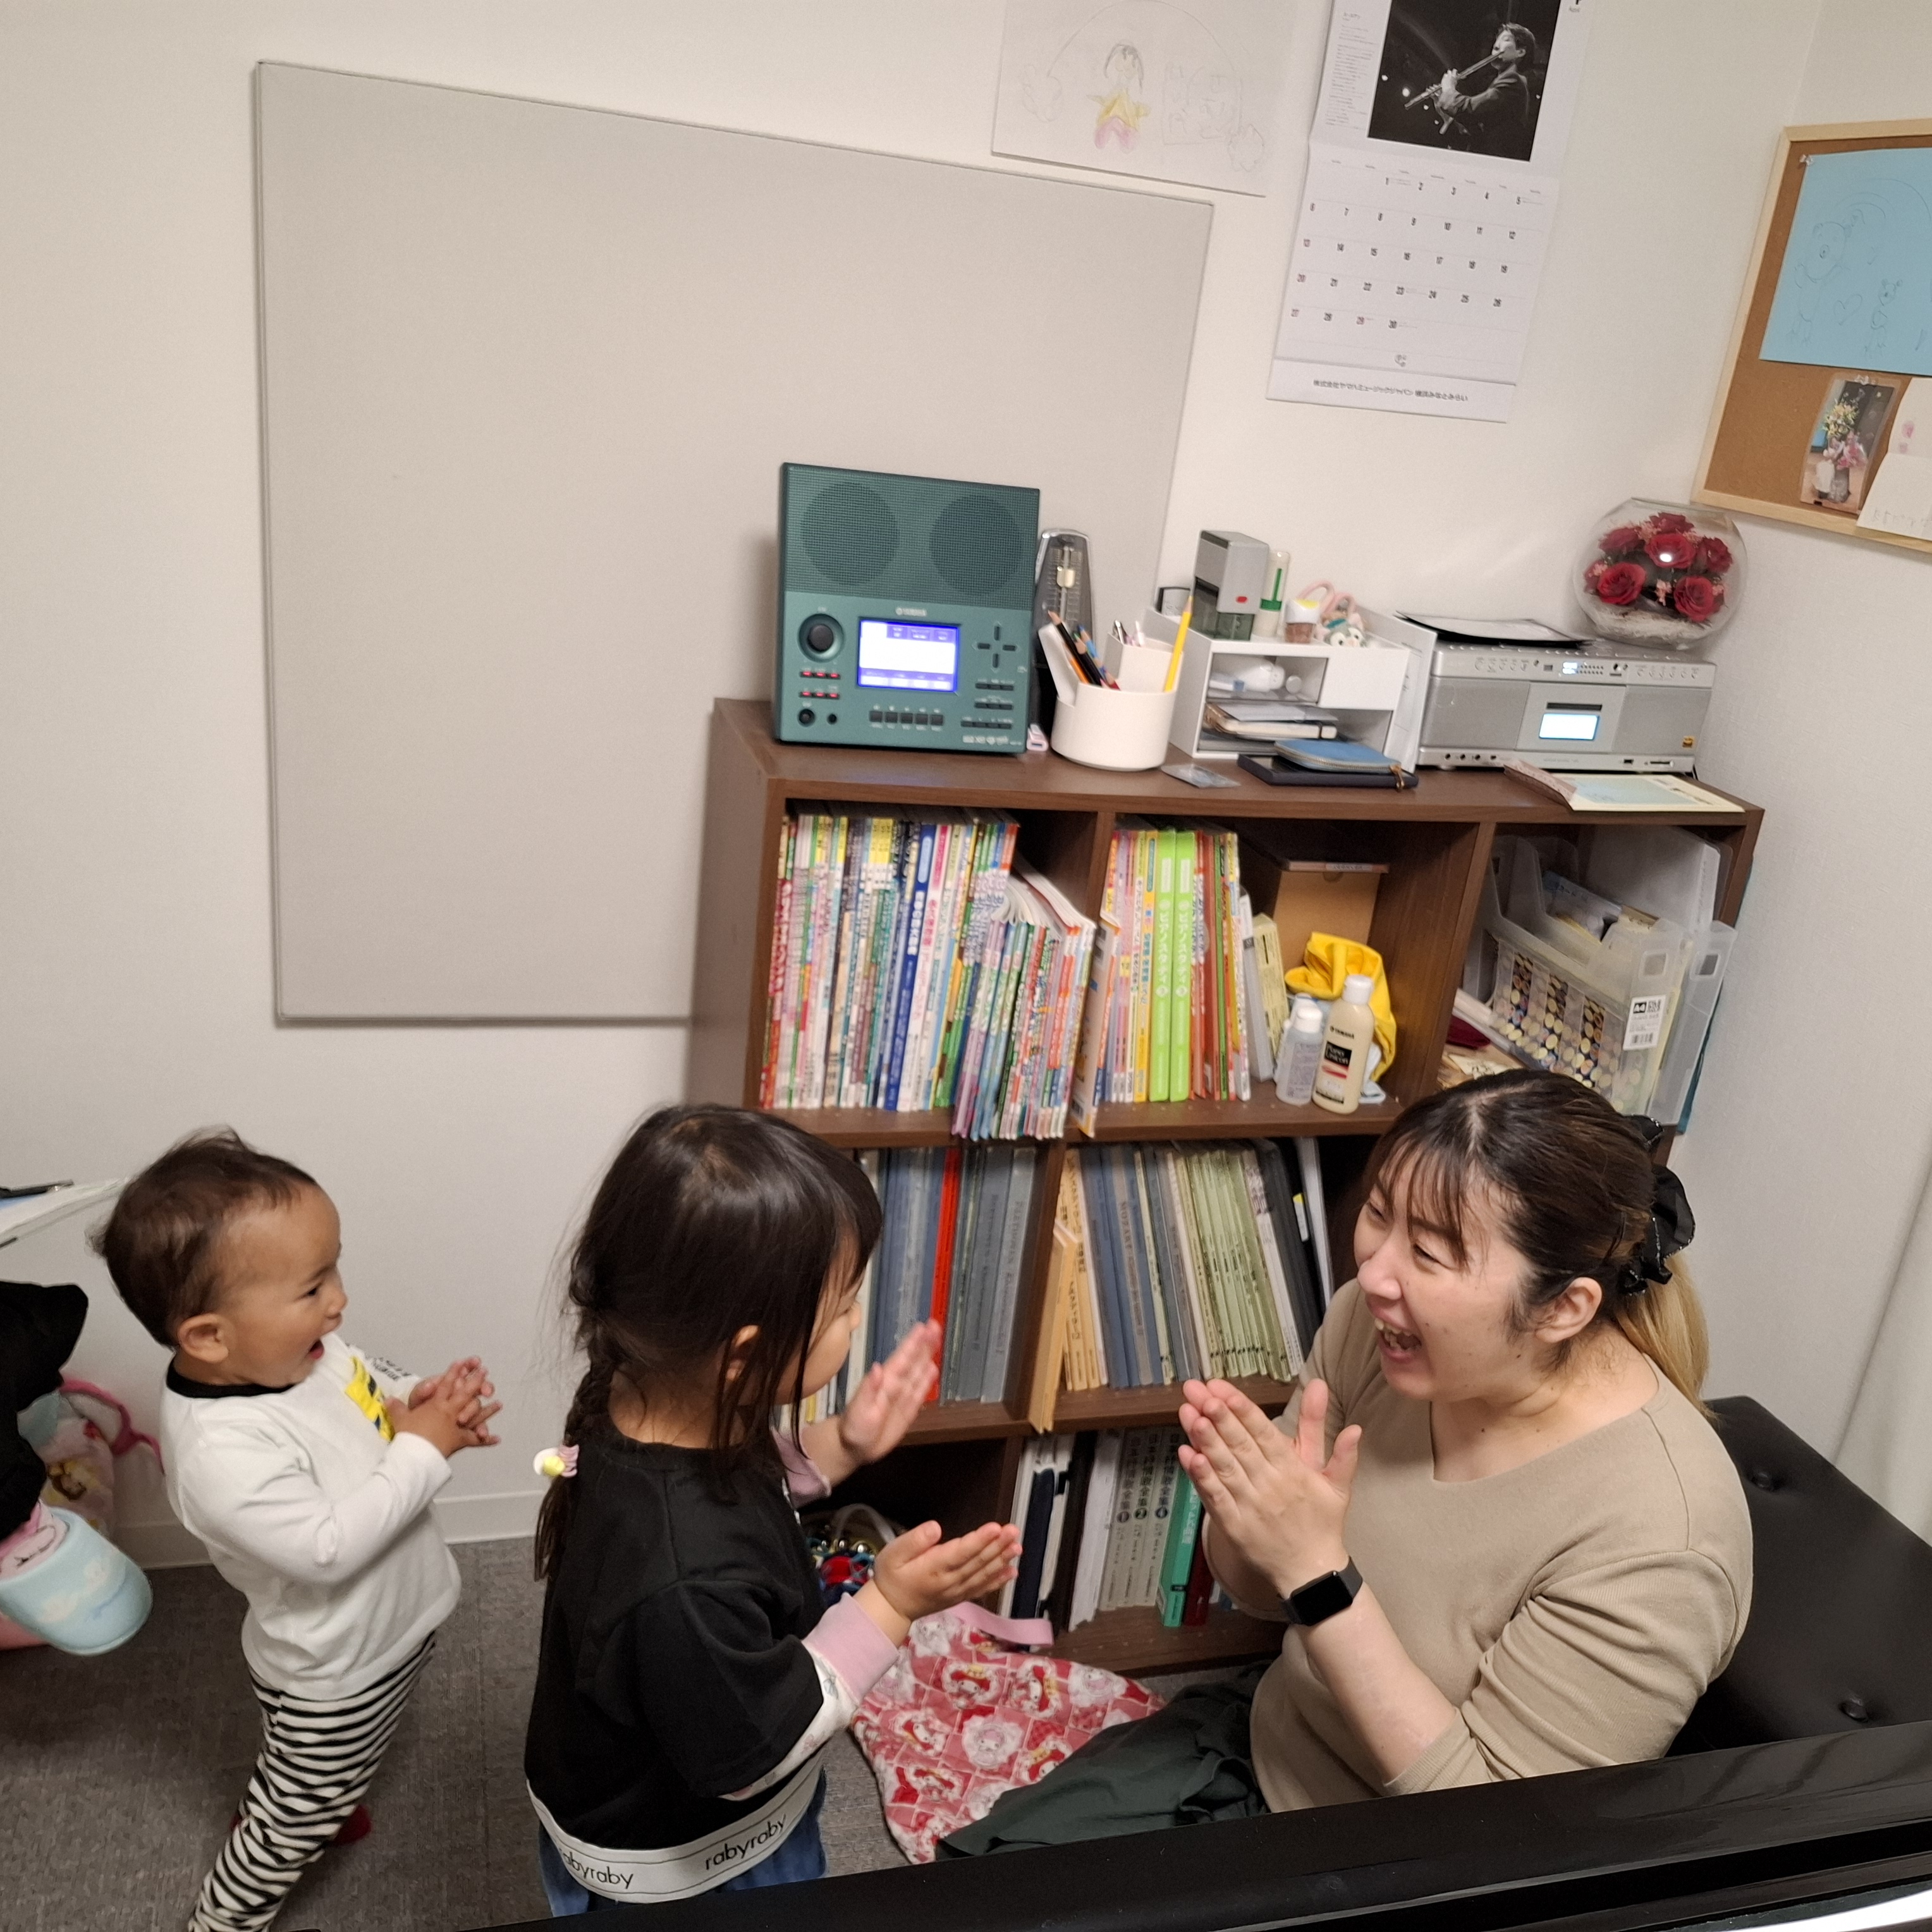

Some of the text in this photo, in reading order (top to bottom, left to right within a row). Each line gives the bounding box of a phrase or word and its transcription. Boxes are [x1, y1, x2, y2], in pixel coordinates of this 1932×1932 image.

[1386, 177, 1521, 205] 1 2 3 4 5
[1345, 207, 1349, 216] 7
[1411, 217, 1416, 226] 9
[1444, 222, 1452, 231] 10
[1509, 231, 1516, 240] 12
[1337, 243, 1344, 252] 14
[1371, 248, 1378, 256] 15
[1297, 273, 1306, 283] 20
[1395, 286, 1405, 295] 23
[1428, 290, 1437, 299] 24
[1460, 294, 1469, 303] 25
[1493, 298, 1502, 307] 26
[1388, 320, 1397, 329] 30
[1634, 1003, 1646, 1013] A4
[706, 1813, 786, 1870] rabyraby
[559, 1847, 634, 1890] abyraby
